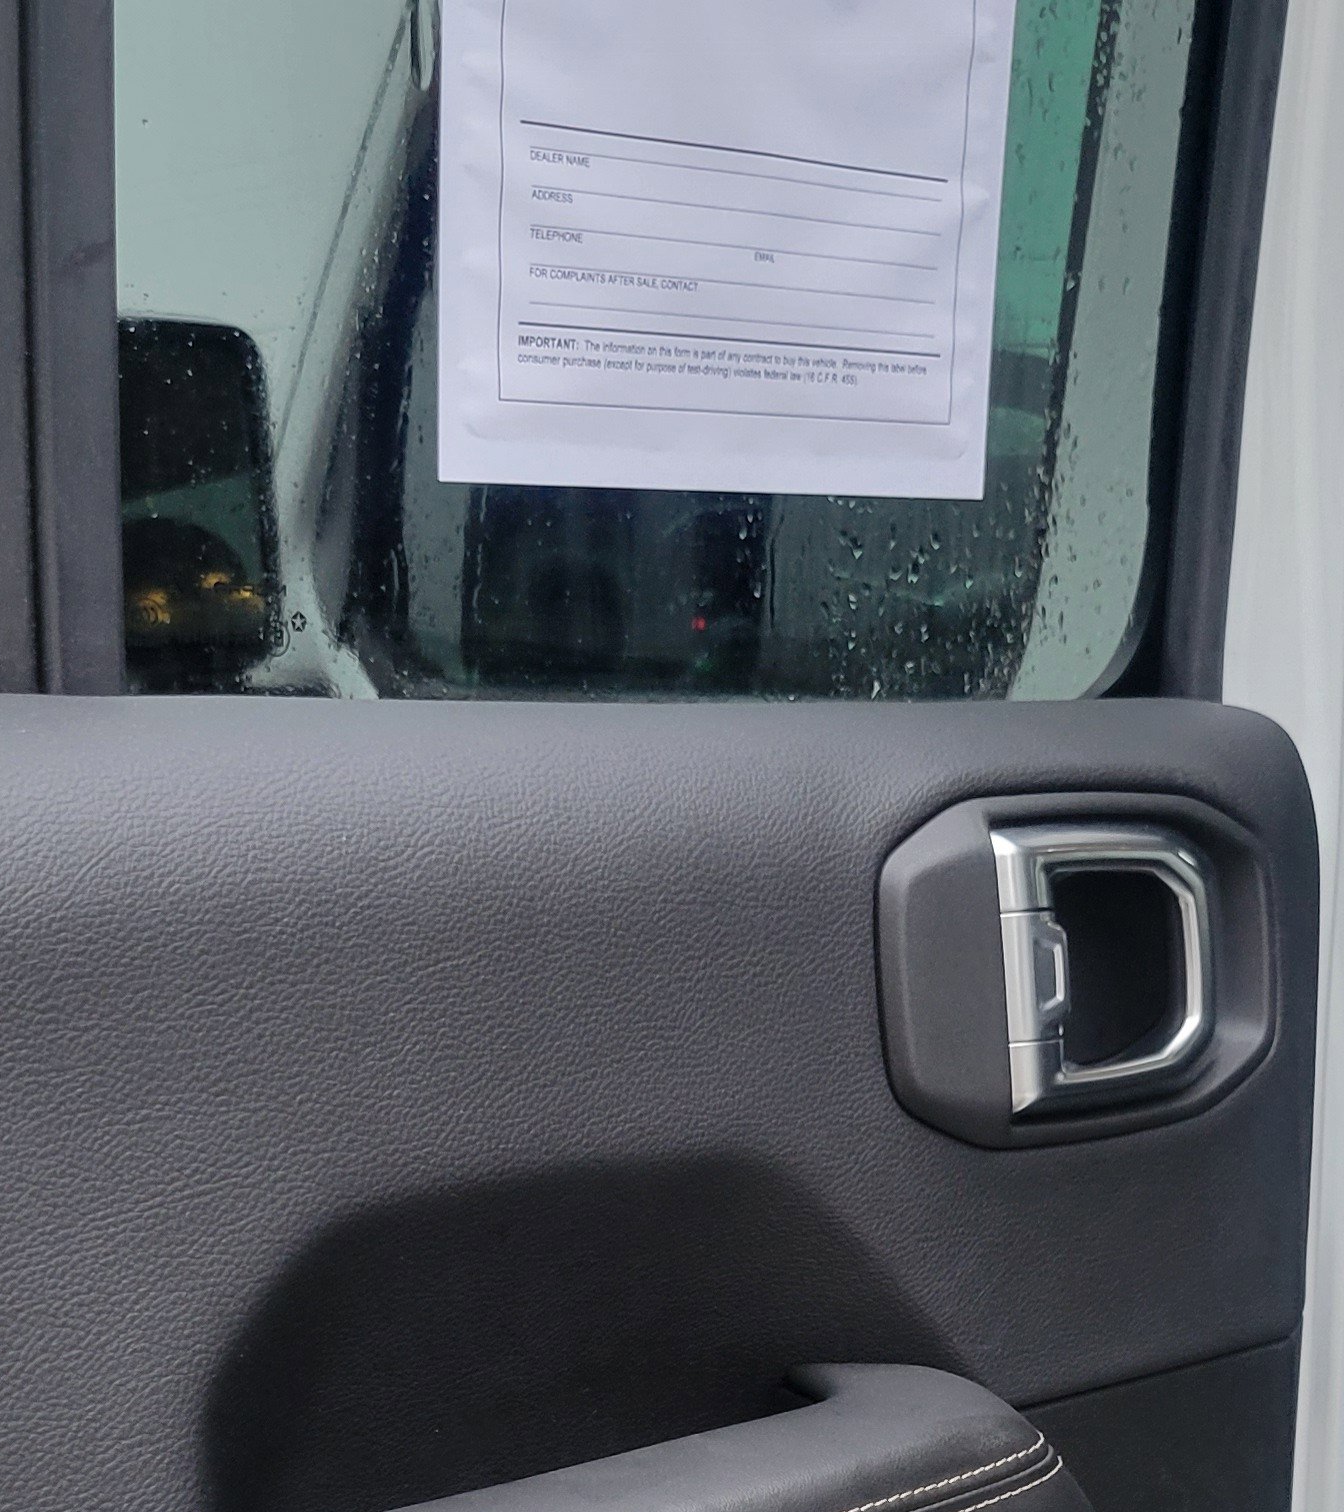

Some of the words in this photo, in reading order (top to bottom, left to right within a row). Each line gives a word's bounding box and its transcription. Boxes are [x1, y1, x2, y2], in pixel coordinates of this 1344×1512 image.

[529, 150, 564, 164] DEALER
[565, 155, 590, 168] NAME
[531, 189, 573, 204] ADDRESS
[529, 227, 583, 243] TELEPHONE
[529, 266, 547, 278] FOR
[549, 269, 606, 284] COMPLAINTS
[608, 274, 634, 287] AFTER
[517, 335, 579, 351] IMPORTANT:
[584, 340, 600, 352] The
[603, 341, 645, 355] information
[517, 353, 560, 366] consumer
[562, 356, 602, 370] purchase
